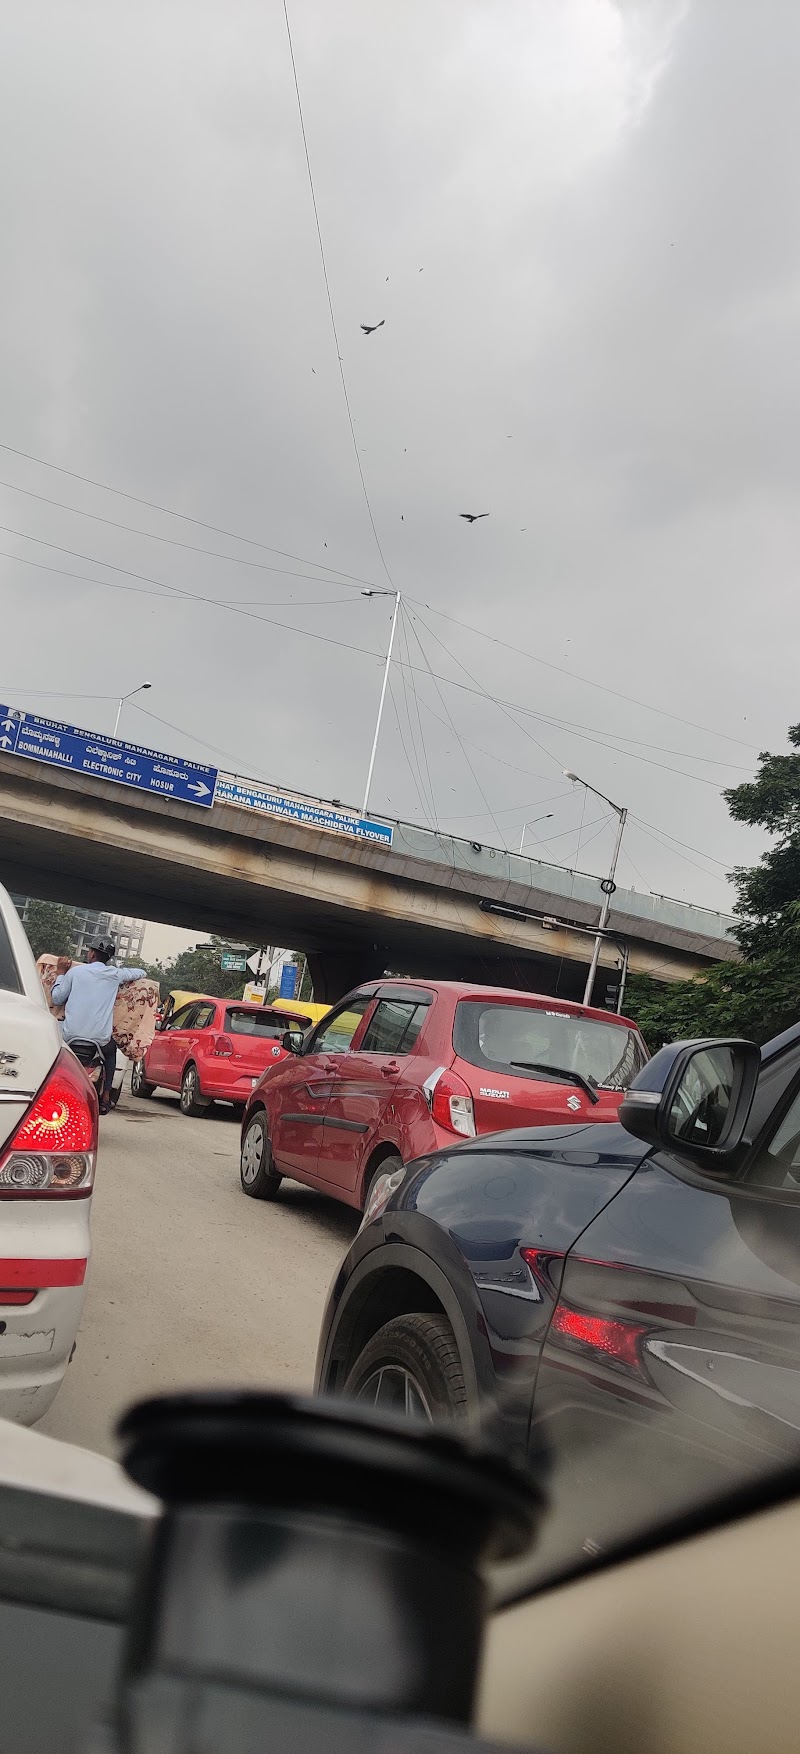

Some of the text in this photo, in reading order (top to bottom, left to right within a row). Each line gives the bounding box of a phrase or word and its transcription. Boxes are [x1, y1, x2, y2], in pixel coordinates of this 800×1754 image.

[18, 741, 74, 764] BOMMANAHALLI
[34, 717, 211, 774] BRUHAT BENGALURU MAHANAGARA PALIKE
[82, 759, 142, 783] ELECTRONIC CITY
[150, 778, 175, 792] HOSUR
[236, 786, 282, 804] BENGALURU
[284, 797, 334, 818] MAHANAGARA
[335, 811, 360, 826] PALIKE
[254, 799, 299, 819] MADIWALA
[301, 811, 355, 834] MAACHIDEVA
[355, 827, 390, 843] FLYOVER
[479, 1087, 510, 1096] MARUTI
